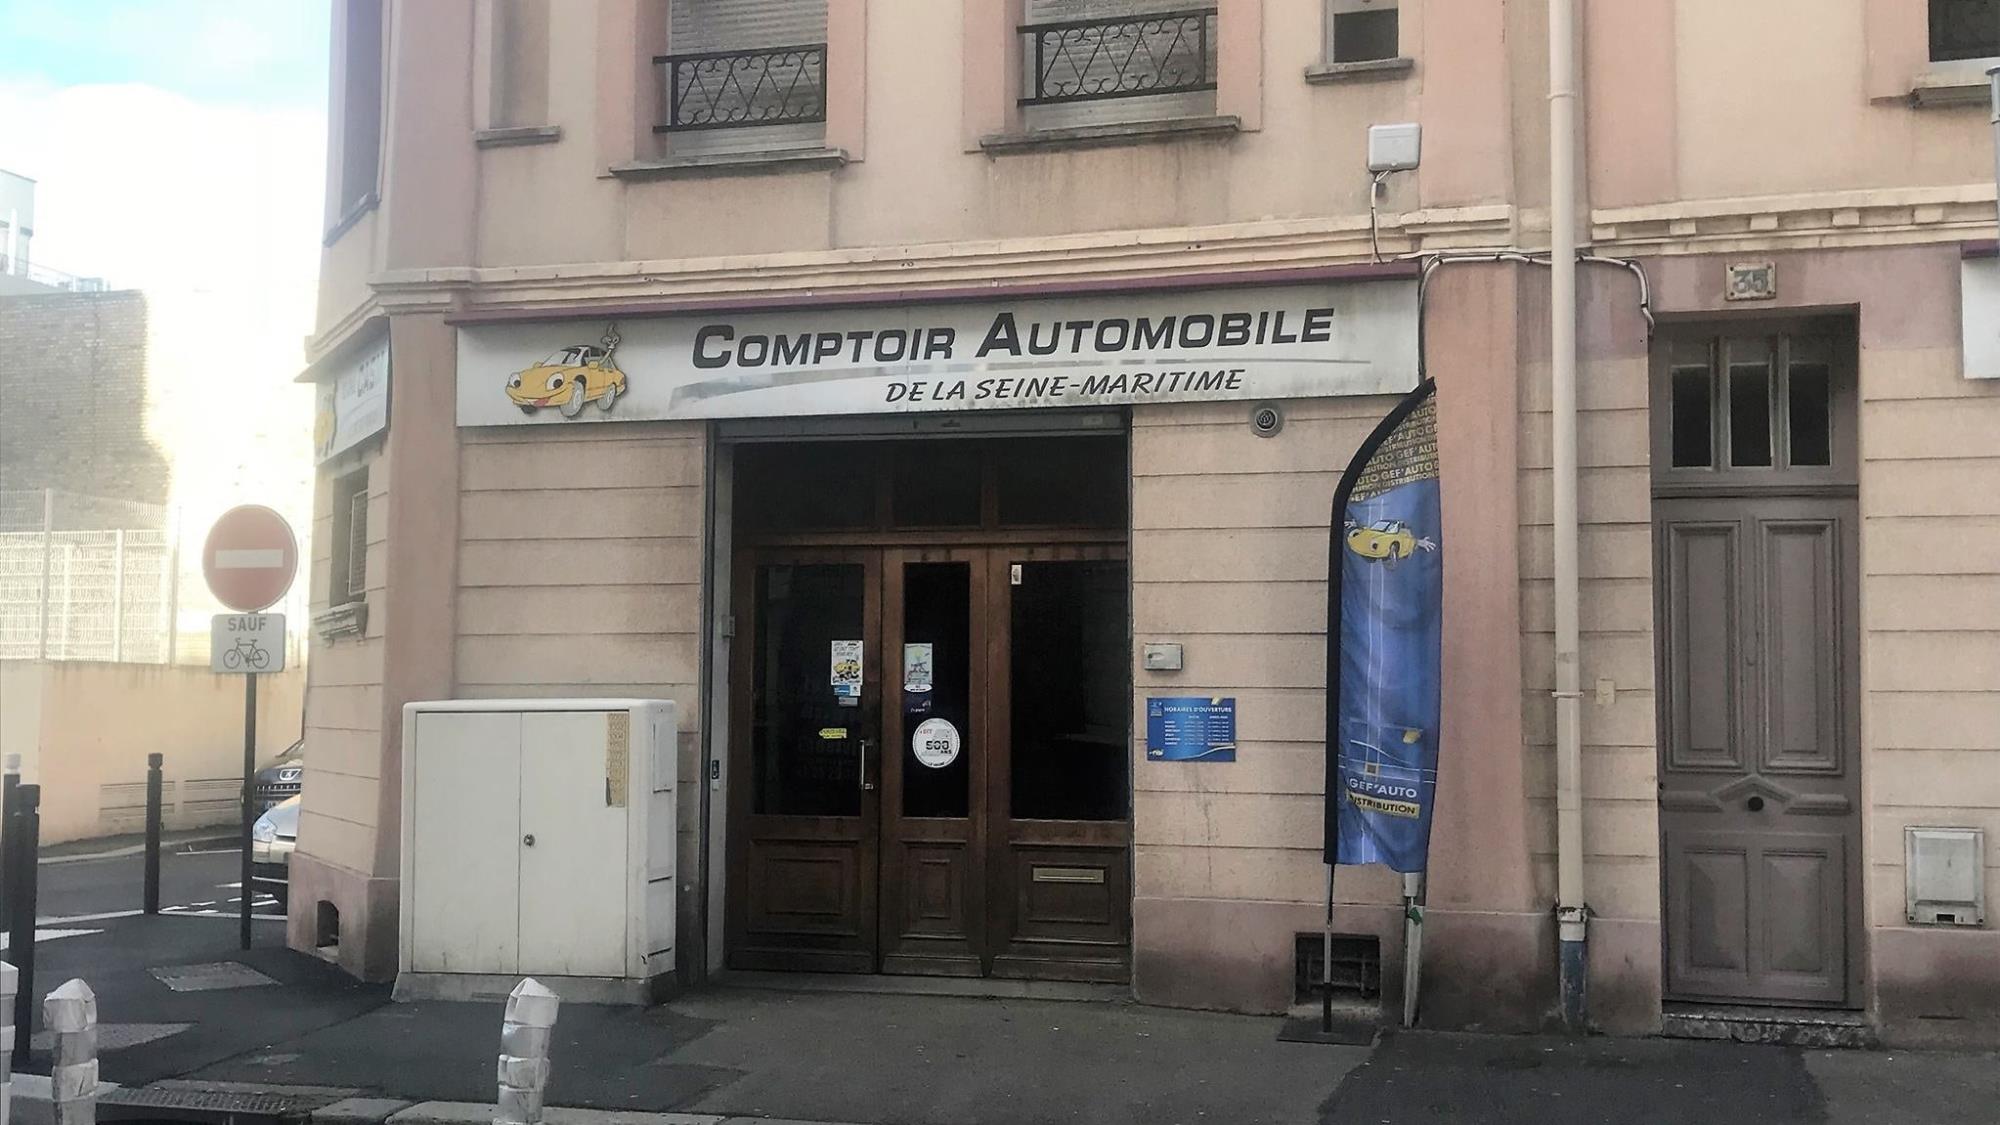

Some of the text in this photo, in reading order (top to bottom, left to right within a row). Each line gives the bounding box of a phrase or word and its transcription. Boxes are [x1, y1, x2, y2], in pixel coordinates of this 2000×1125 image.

[975, 307, 1334, 358] AUTOMOBILE
[885, 369, 1246, 403] DE LA SEINE-MARITIME
[227, 616, 267, 632] SAUF
[925, 740, 949, 750] 500
[1349, 778, 1417, 798] GEF'AUTO
